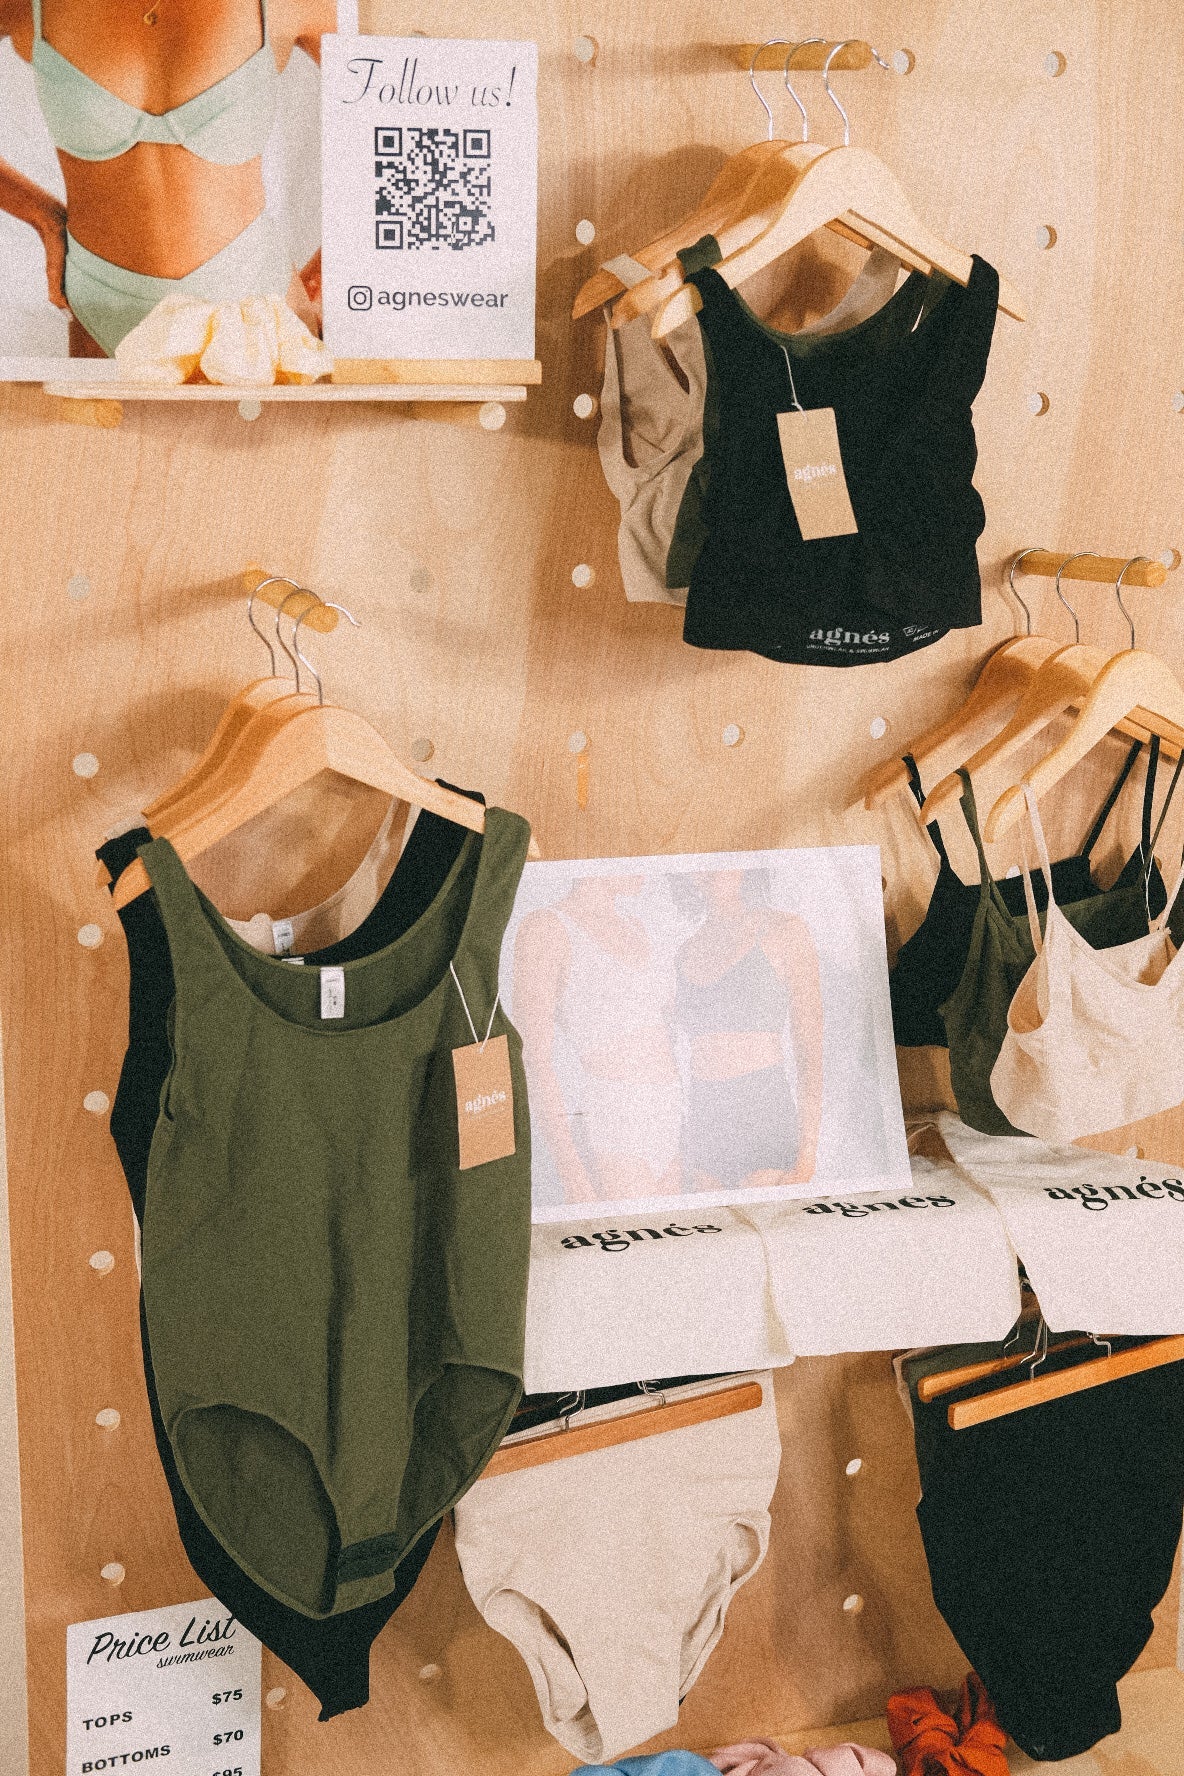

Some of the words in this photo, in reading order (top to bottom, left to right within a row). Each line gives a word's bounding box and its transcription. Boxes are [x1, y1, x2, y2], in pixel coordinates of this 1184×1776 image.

[343, 58, 458, 105] Follow
[471, 66, 517, 108] us!
[377, 290, 509, 311] agneswear
[809, 627, 891, 647] agnés
[1043, 1175, 1184, 1211] agnés
[560, 1223, 722, 1252] agnés
[86, 1631, 170, 1665] Price
[179, 1616, 237, 1648] List
[156, 1643, 235, 1669] swimwear
[83, 1711, 133, 1731] TOPS
[211, 1688, 243, 1706] $75
[82, 1744, 171, 1774] BOTTOMS
[213, 1729, 244, 1746] $70
